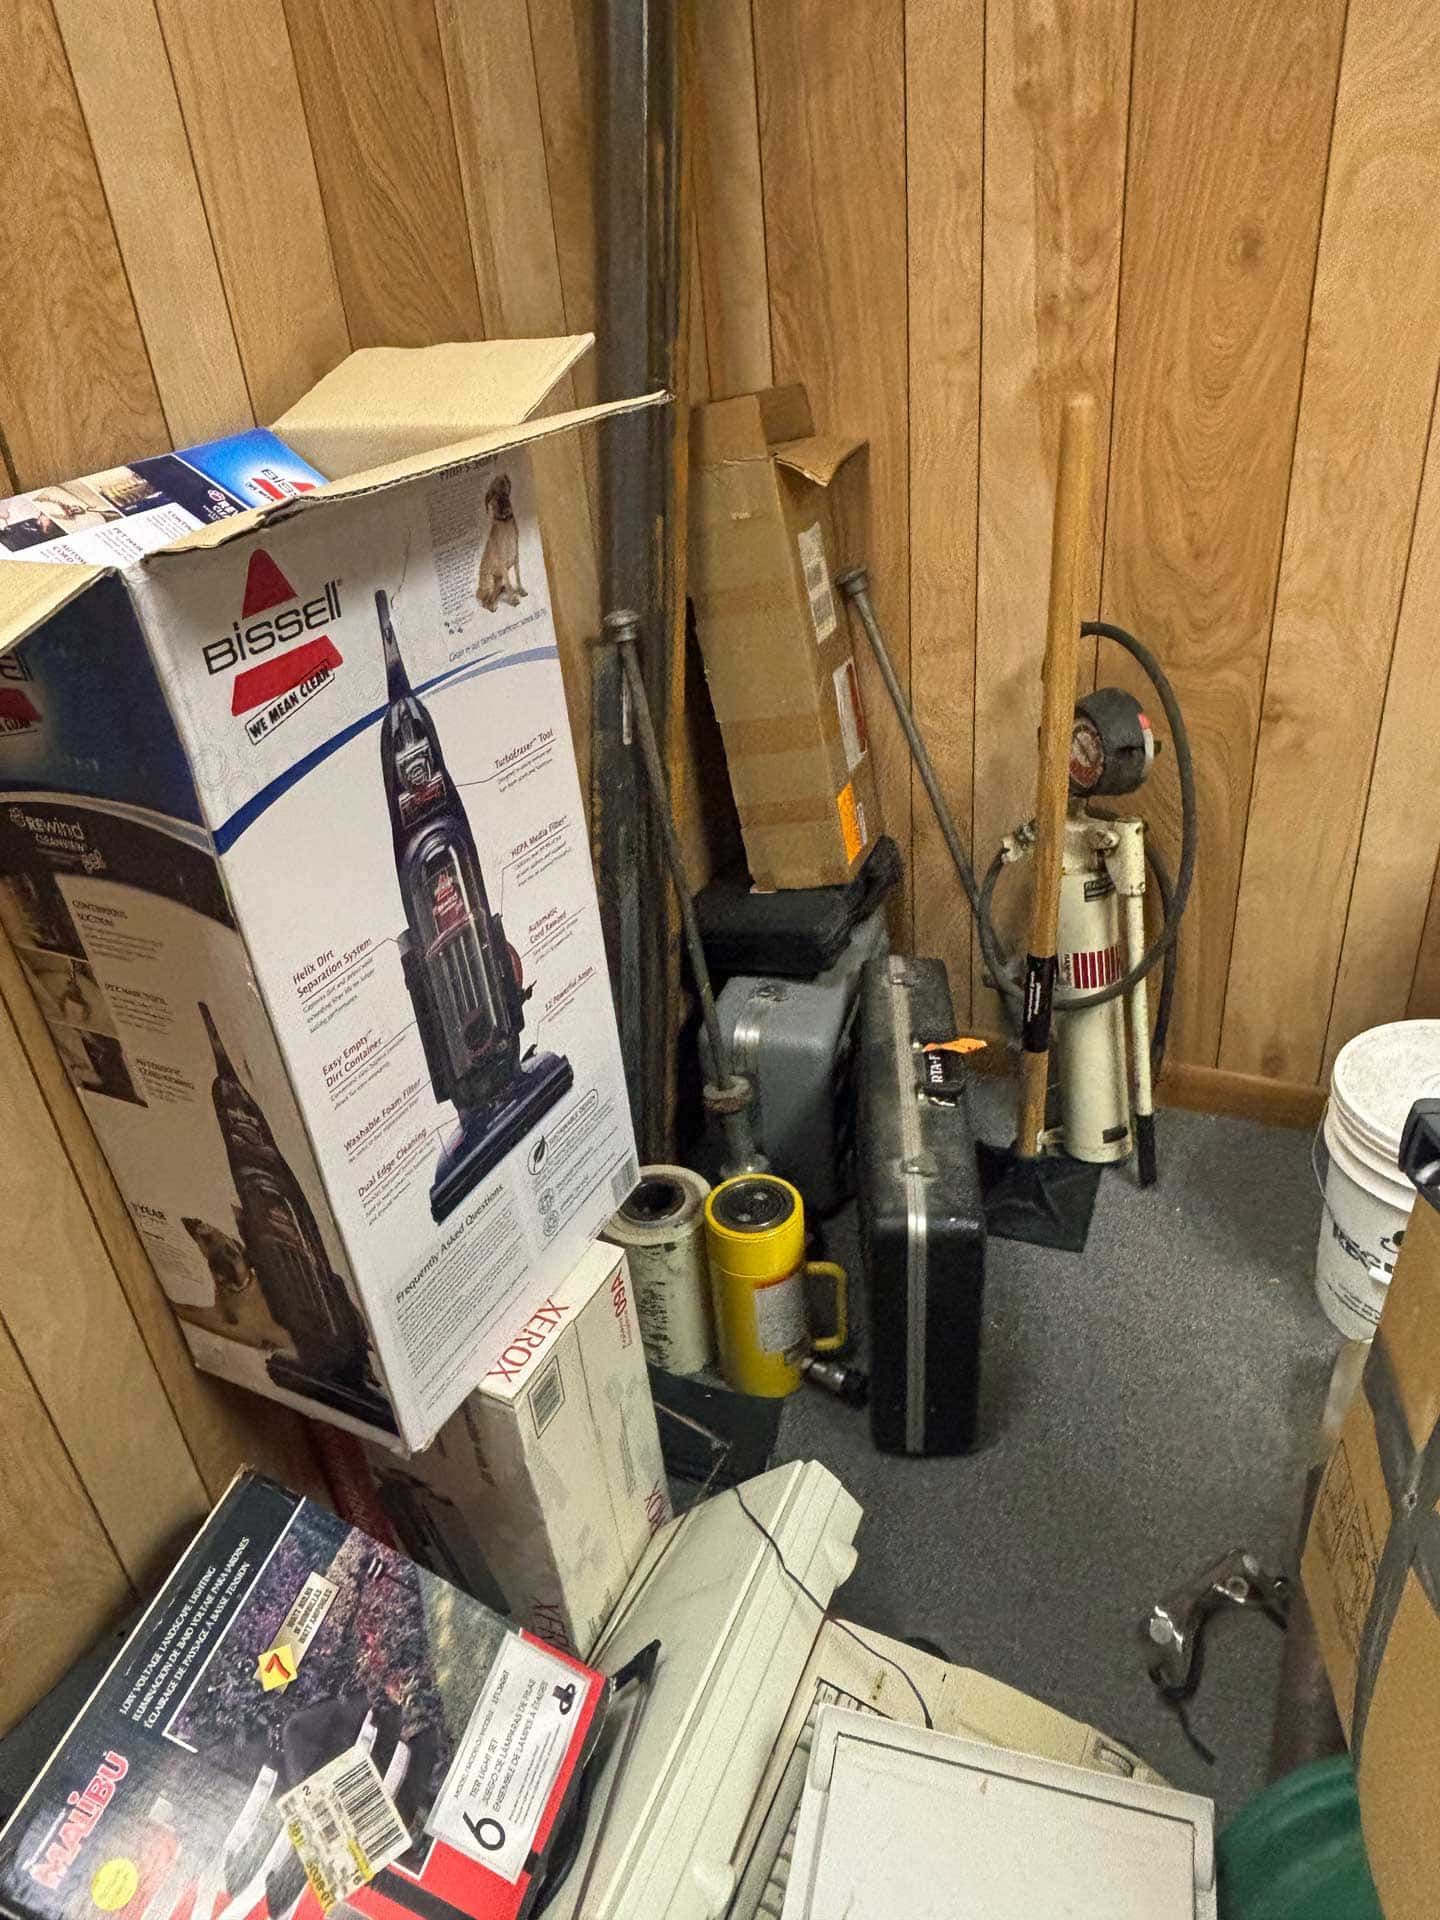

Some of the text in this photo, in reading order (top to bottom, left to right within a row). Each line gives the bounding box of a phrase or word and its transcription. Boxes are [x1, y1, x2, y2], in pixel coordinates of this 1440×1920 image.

[248, 669, 333, 739] WE MEAN CLEAN
[538, 728, 553, 741] Tool
[293, 950, 334, 984] Helix Dirt
[297, 960, 343, 998] Separation
[343, 938, 371, 964] System
[322, 1056, 342, 1075] Easy
[326, 1038, 381, 1087] Dirt Container
[344, 1078, 421, 1151] Washable Foam Filter
[358, 1128, 427, 1196] Dual Edge Cleaning
[396, 1255, 438, 1303] Frequently
[441, 1222, 464, 1255] Asked
[465, 1184, 503, 1226] Questions
[487, 1298, 570, 1383] XEROX
[168, 1649, 180, 1663] DE
[176, 1627, 193, 1649] BAJO
[190, 1594, 215, 1626] VOLTAJE
[211, 1573, 228, 1594] PARA
[224, 1537, 249, 1573] JARDINES
[174, 1667, 186, 1680] DE
[182, 1629, 209, 1666] PAYSAGE
[225, 1562, 250, 1595] TENSION
[530, 1596, 570, 1648] XER
[119, 1568, 216, 1714] LOW VOLTAGE LANDSCAPE LIGHTING
[264, 1652, 292, 1680] 7
[494, 1759, 504, 1773] DE
[518, 1701, 528, 1713] DE
[469, 1738, 498, 1797] TIER LIGHT SET
[493, 1767, 515, 1812] ENSEMBLE
[511, 1753, 520, 1766] DE
[462, 1811, 506, 1851] 6
